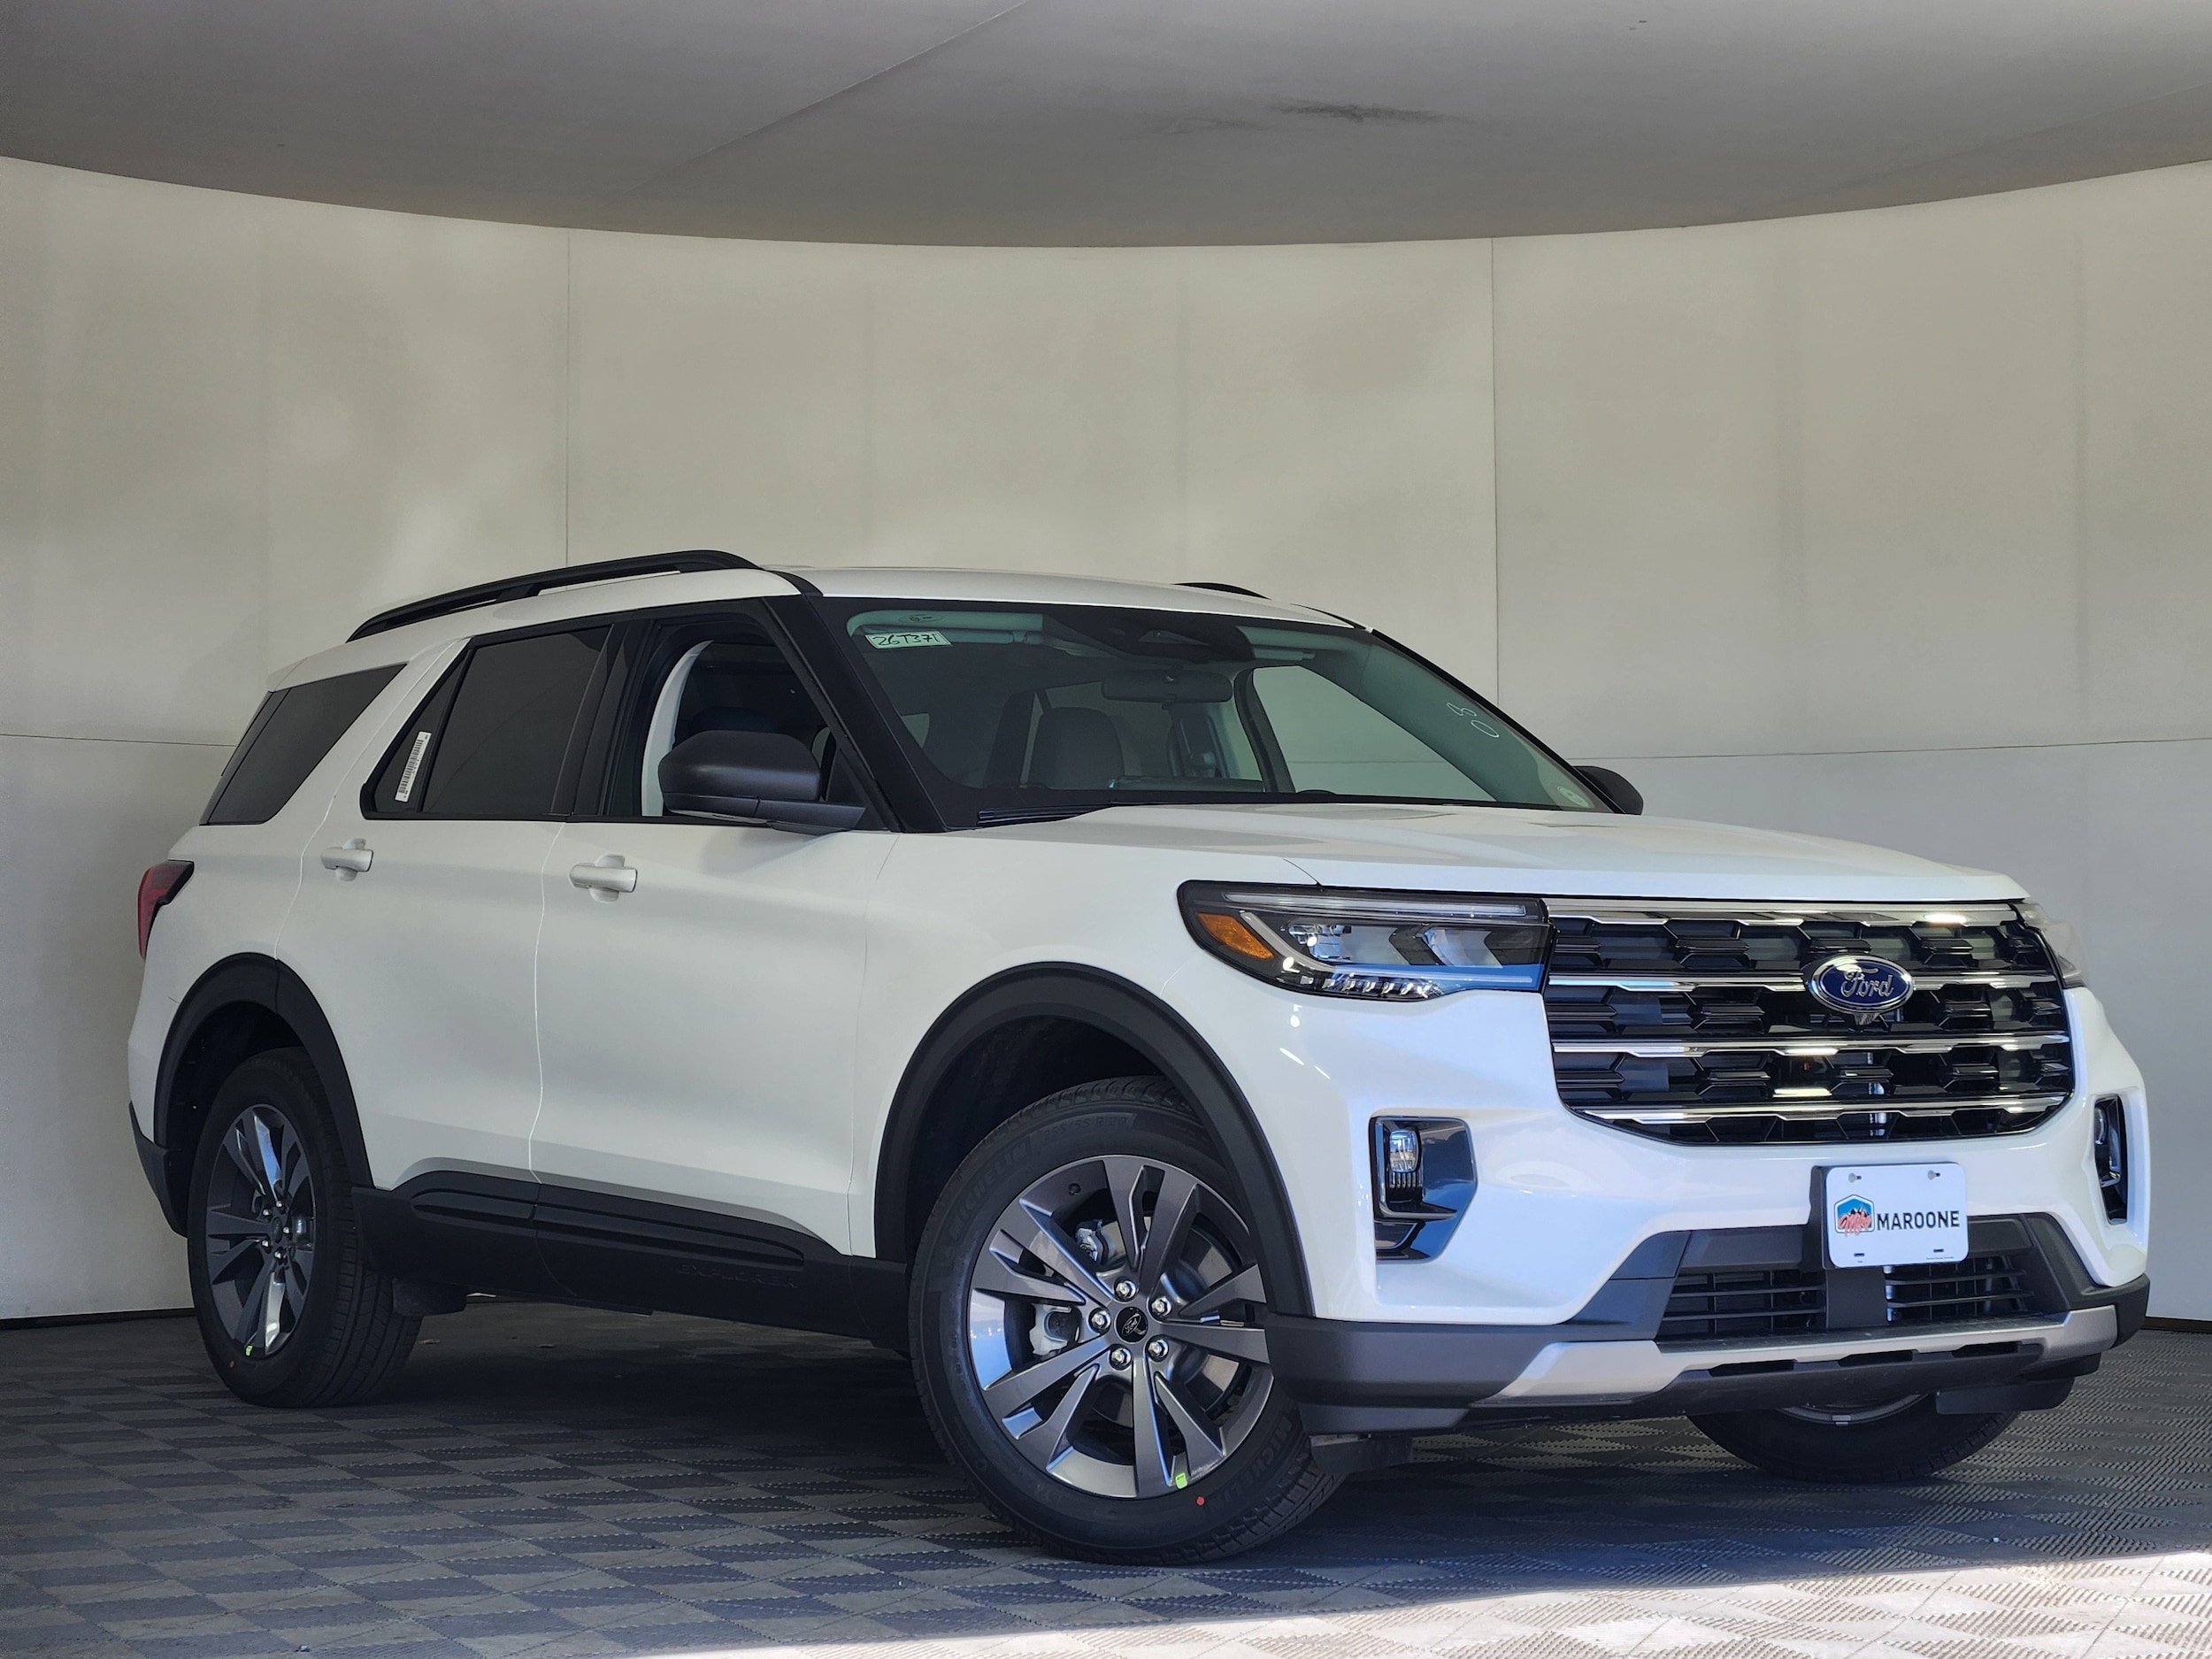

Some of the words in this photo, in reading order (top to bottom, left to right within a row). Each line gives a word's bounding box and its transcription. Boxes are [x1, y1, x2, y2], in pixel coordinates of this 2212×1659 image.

[872, 633, 940, 646] 26T371
[1835, 963, 1894, 998] Ford
[948, 1141, 1027, 1240] MICHELIN
[1877, 1210, 1960, 1231] MAROONE
[678, 1263, 799, 1288] EXPLORER
[1206, 1416, 1293, 1514] MICHELIN
